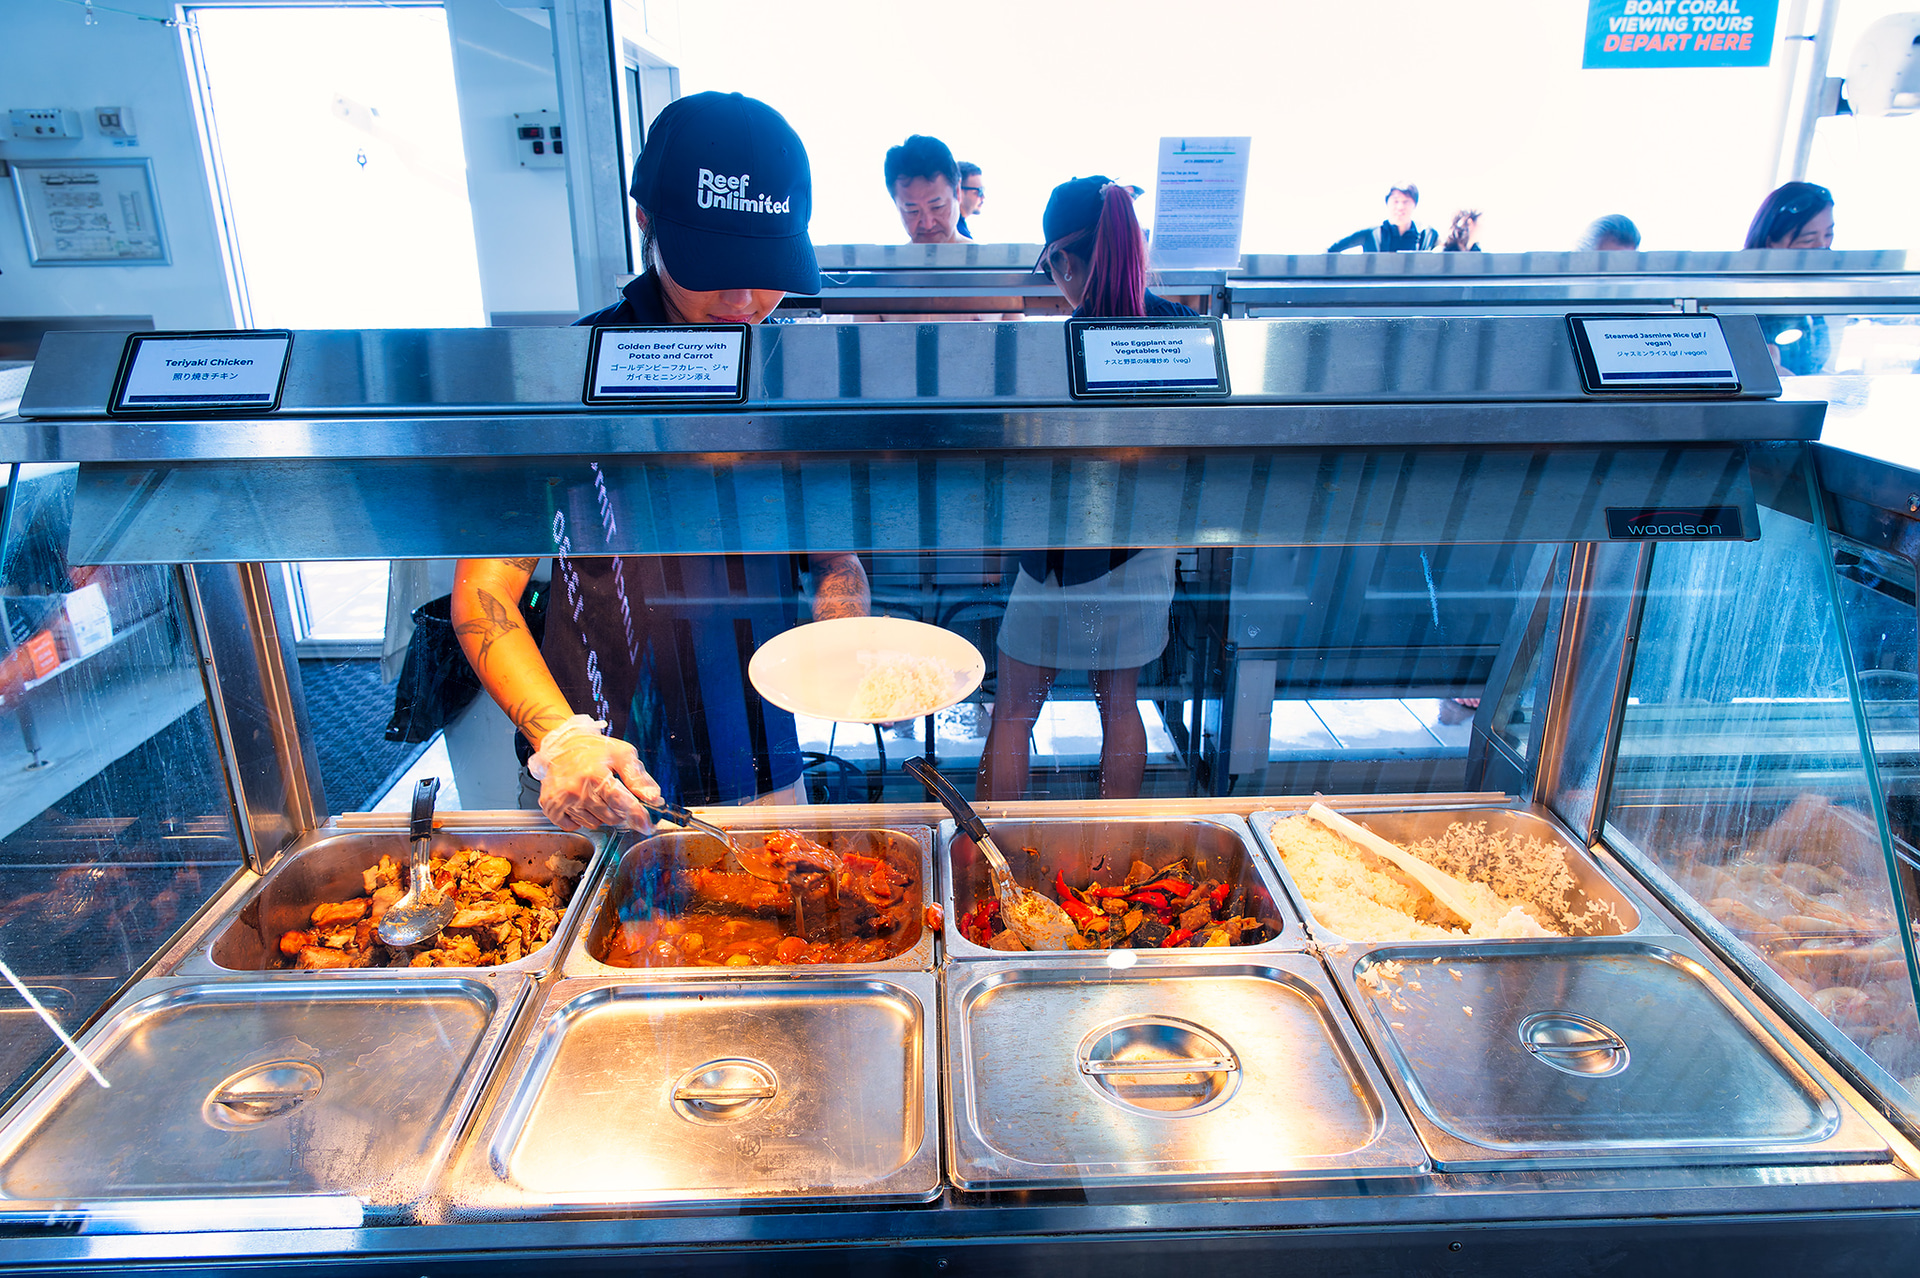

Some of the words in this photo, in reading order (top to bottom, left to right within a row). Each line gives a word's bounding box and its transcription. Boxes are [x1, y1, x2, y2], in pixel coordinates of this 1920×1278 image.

[1624, 0, 1676, 15] BOAT
[1677, 0, 1740, 15] CORAL
[1609, 17, 1688, 32] VIEWING
[1692, 16, 1754, 31] TOURS
[1603, 34, 1692, 52] DEPART
[1693, 33, 1754, 51] HERE
[698, 168, 750, 198] Reef
[697, 189, 790, 214] Unlimited
[653, 342, 676, 350] Beef
[677, 343, 704, 351] Curry
[705, 342, 727, 350] with
[1131, 340, 1166, 348] Eggplant
[628, 352, 660, 360] Potato
[165, 359, 207, 368] Teriyaki
[209, 358, 254, 366] Chicken
[172, 372, 239, 381] 照り焼きチキン
[626, 373, 711, 381] ガイモとニンジン添え
[1627, 522, 1722, 535] woodson
